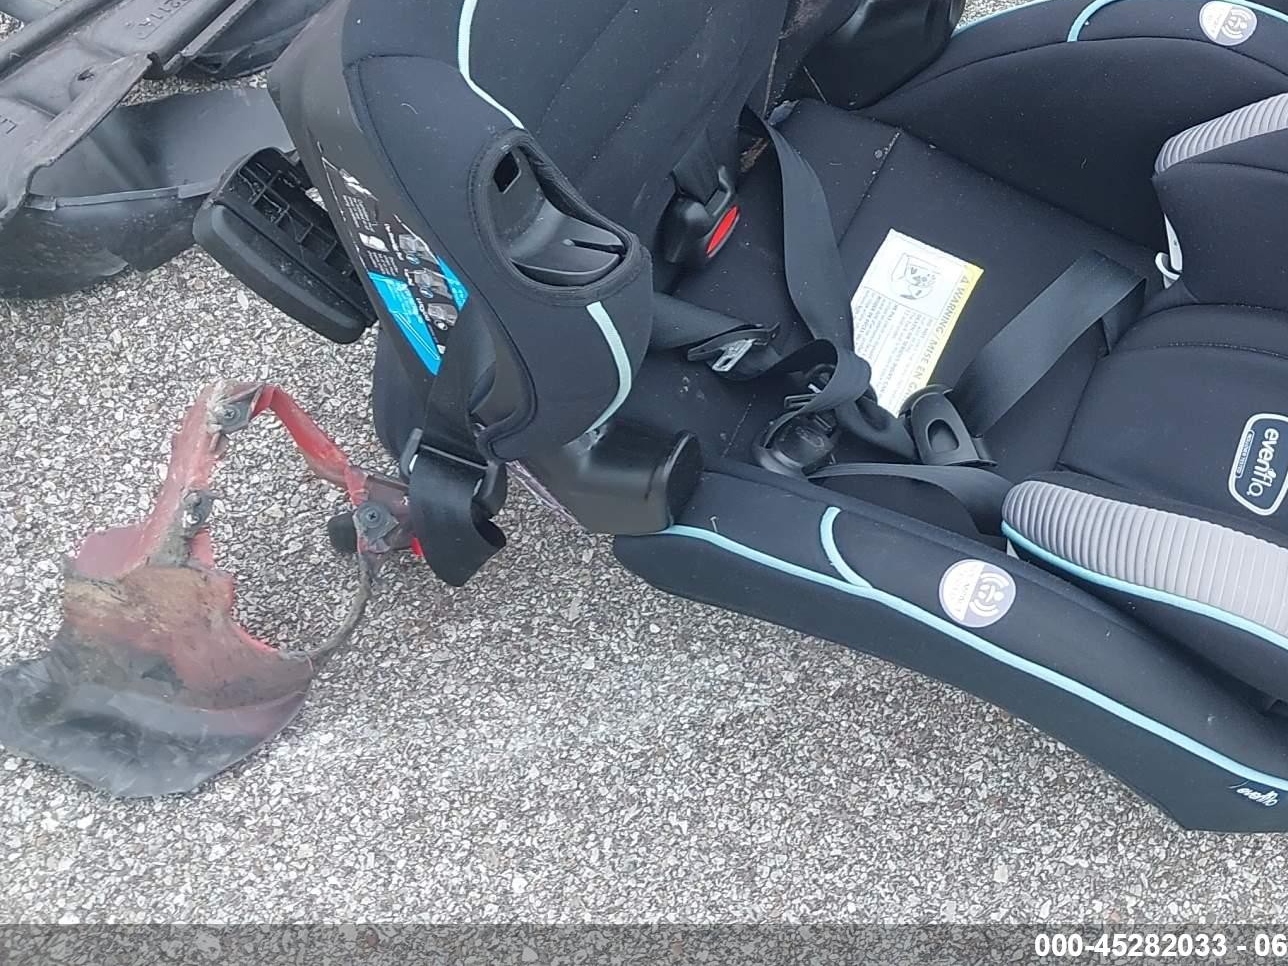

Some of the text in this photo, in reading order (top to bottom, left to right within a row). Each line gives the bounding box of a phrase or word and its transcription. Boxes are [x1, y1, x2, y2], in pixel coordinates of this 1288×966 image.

[936, 286, 966, 335] WARNING
[920, 338, 938, 365] MISE
[912, 366, 926, 380] EN
[1246, 428, 1280, 497] evenflo
